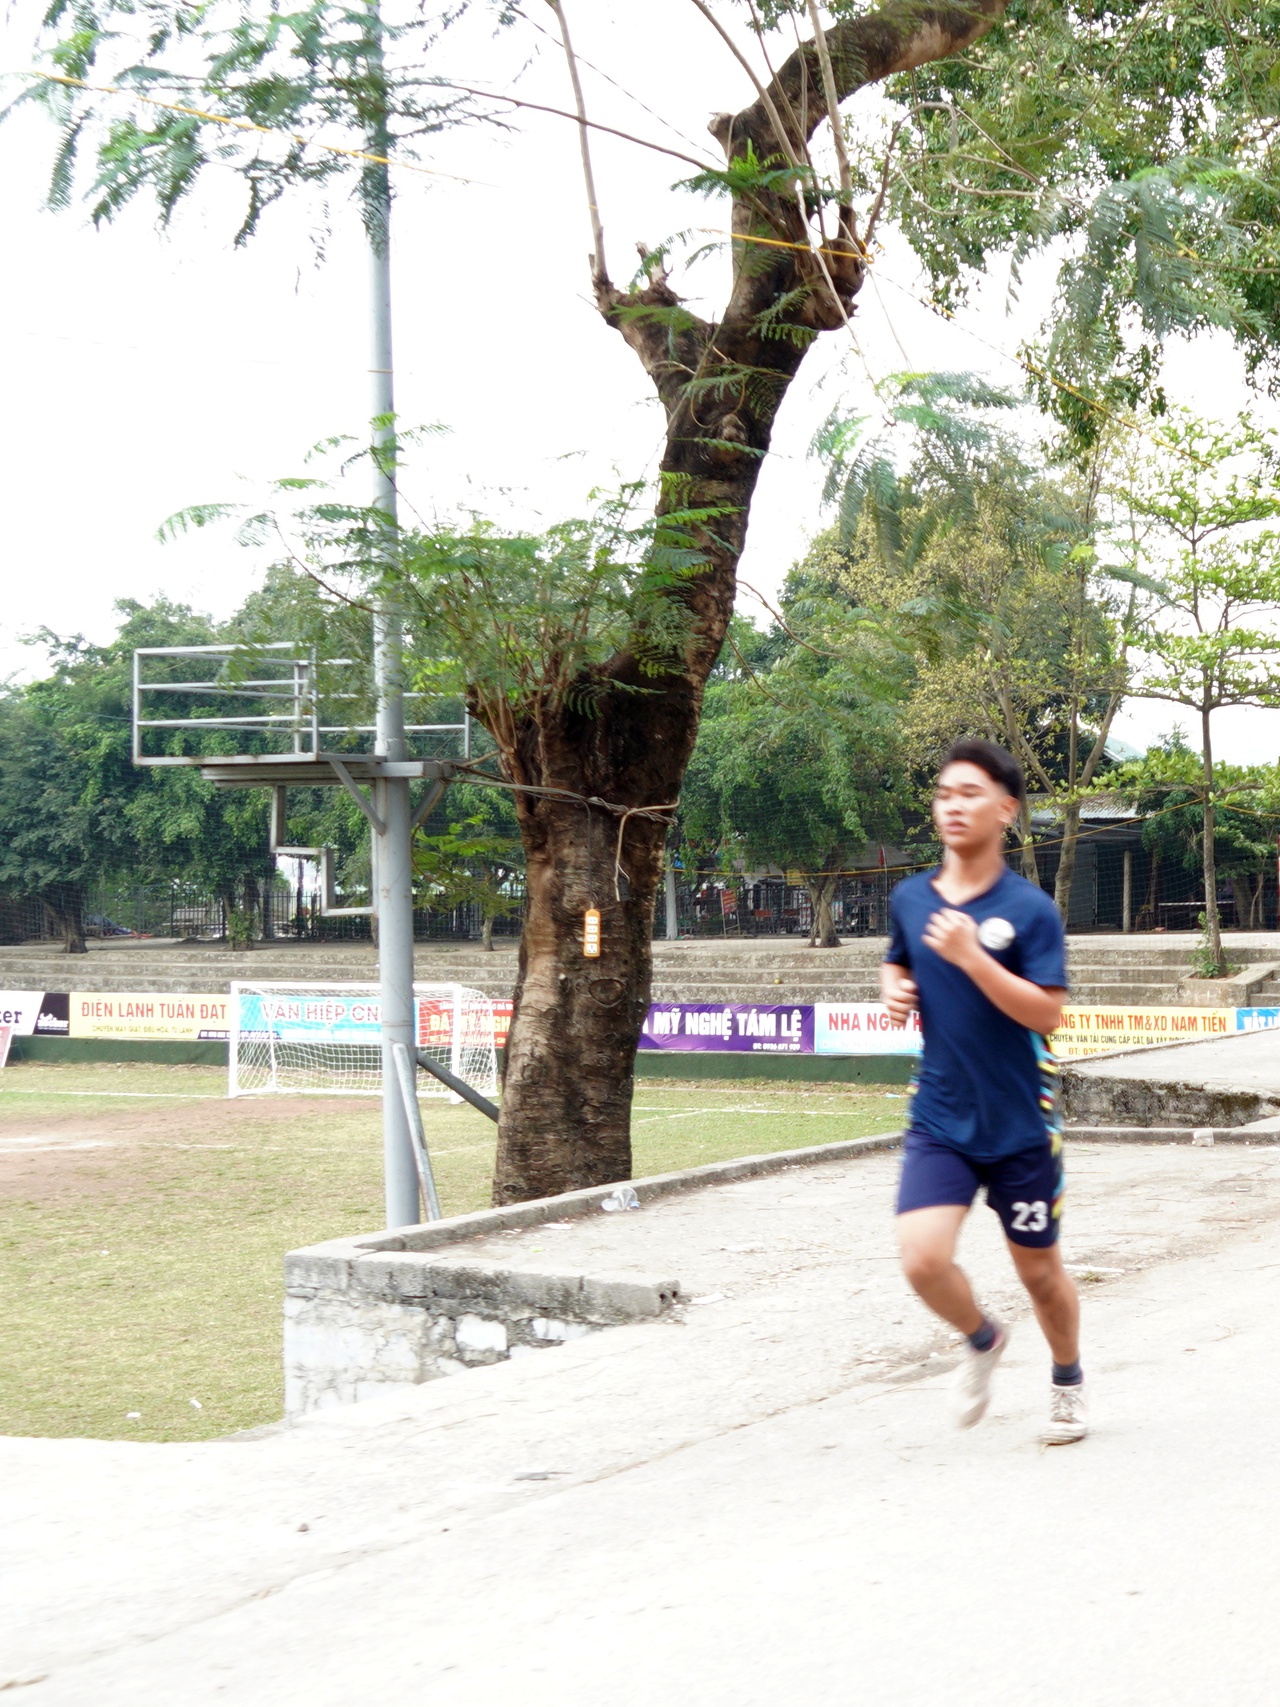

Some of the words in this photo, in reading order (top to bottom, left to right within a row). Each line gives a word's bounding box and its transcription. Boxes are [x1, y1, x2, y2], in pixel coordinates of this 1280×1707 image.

[0, 1009, 23, 1024] er
[351, 1004, 384, 1022] CN
[653, 1008, 681, 1035] MỸ
[685, 1008, 732, 1041] NGHỆ
[736, 1008, 776, 1036] TÁM
[781, 1009, 802, 1042] LỆ
[1078, 1014, 1091, 1030] TY
[1095, 1014, 1124, 1030] TNHH
[1127, 1014, 1167, 1031] TM&XD
[1171, 1015, 1198, 1032] NAM
[1011, 1200, 1049, 1233] 23
